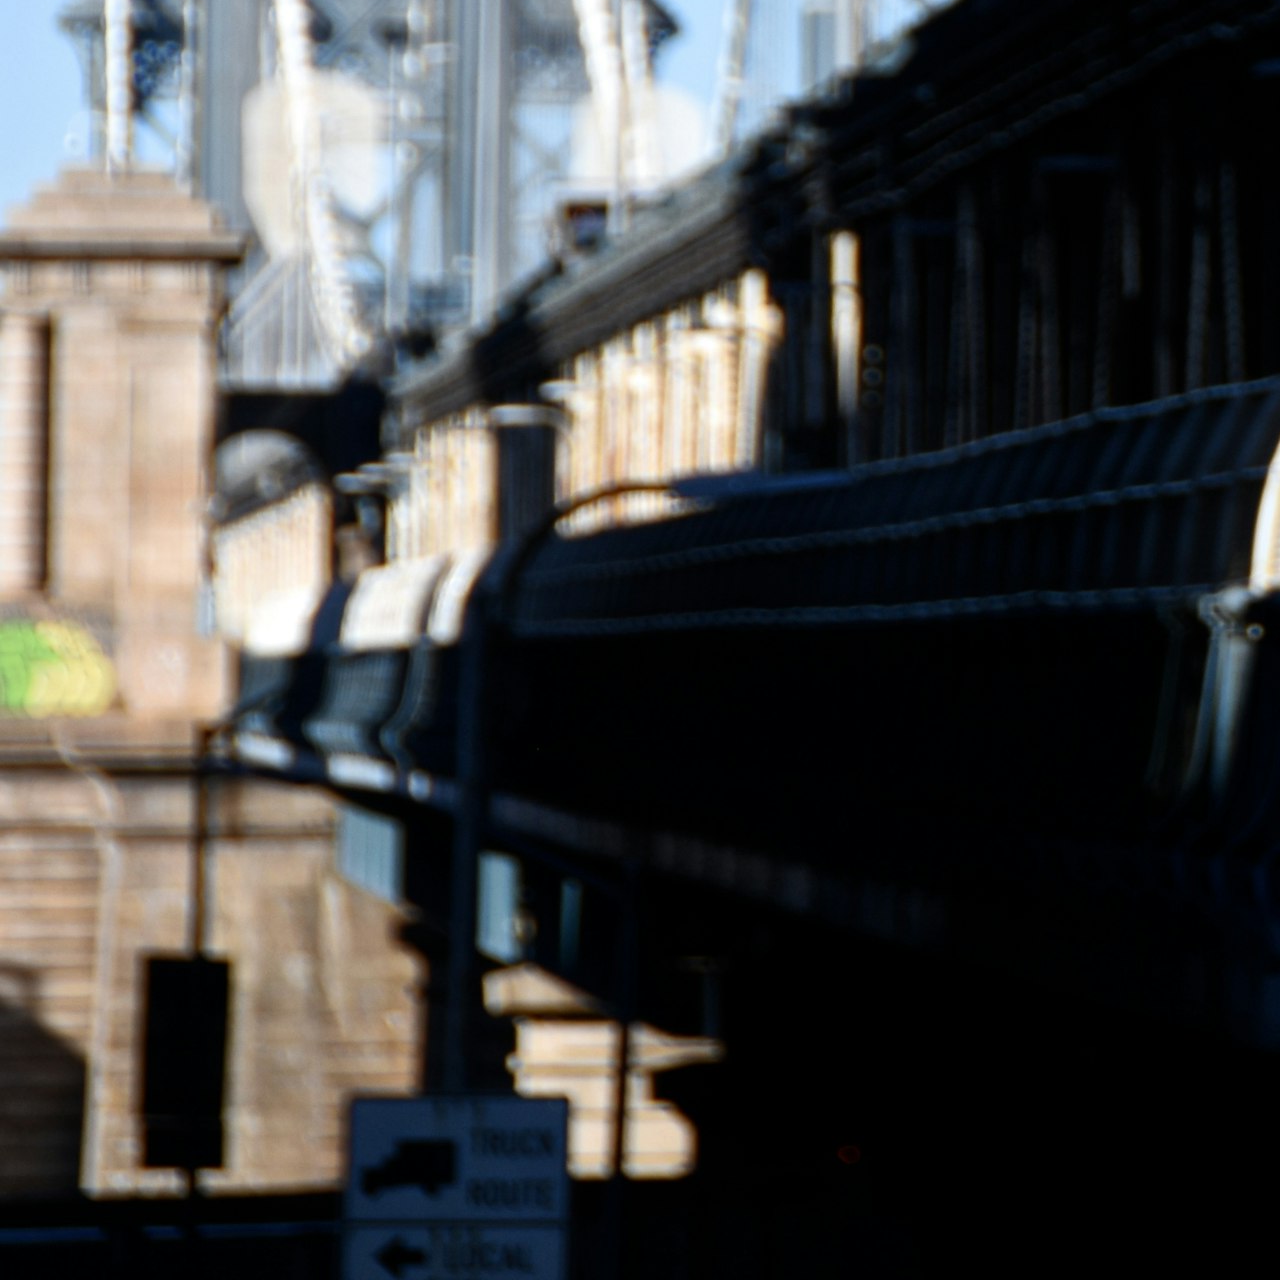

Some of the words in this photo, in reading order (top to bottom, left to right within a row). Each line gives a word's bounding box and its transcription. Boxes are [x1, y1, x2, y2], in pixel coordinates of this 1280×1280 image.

[471, 1127, 555, 1157] TRUCK
[467, 1178, 554, 1208] ROUTE
[443, 1242, 533, 1273] LOCAL
